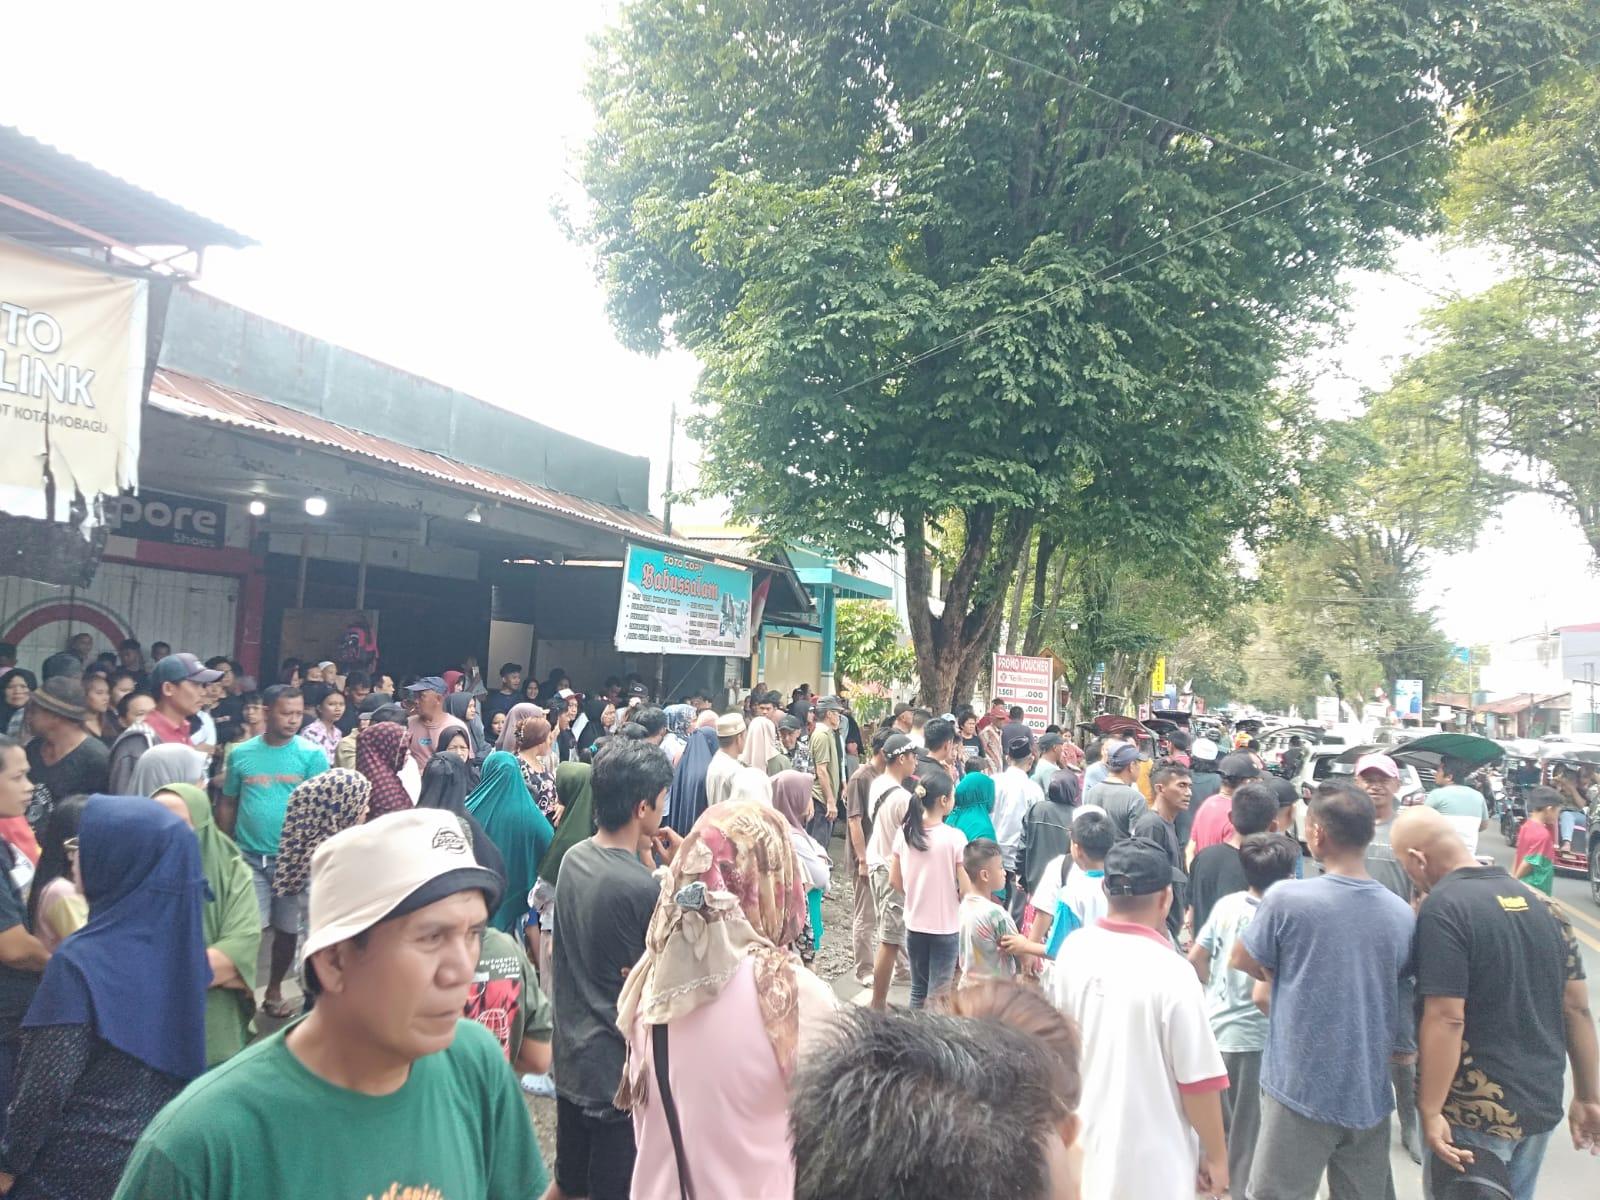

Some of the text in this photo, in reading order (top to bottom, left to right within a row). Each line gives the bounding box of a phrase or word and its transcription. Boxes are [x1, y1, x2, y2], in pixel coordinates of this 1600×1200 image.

[0, 348, 96, 409] LINK
[14, 407, 108, 433] KOTAMOBAGU
[664, 556, 703, 570] FOTO COPY
[998, 657, 1049, 673] PROMO VOUCHER
